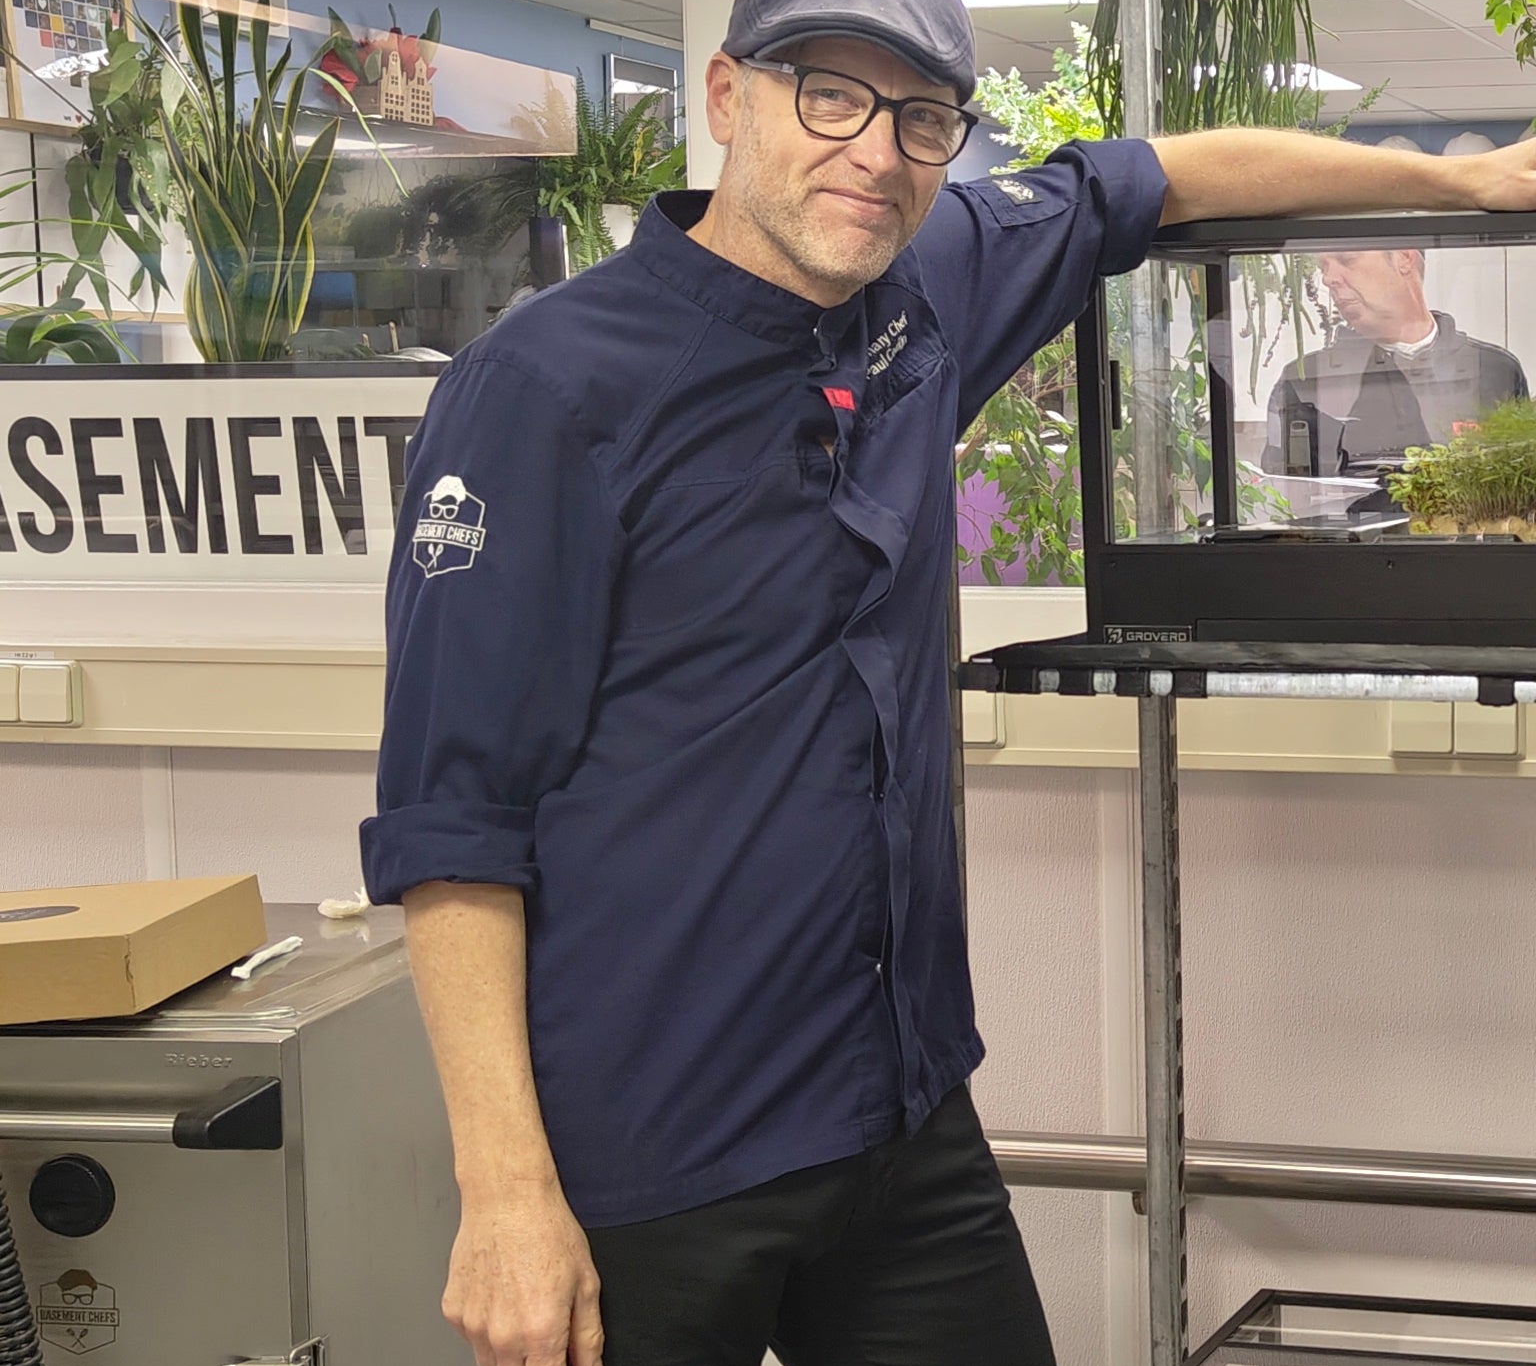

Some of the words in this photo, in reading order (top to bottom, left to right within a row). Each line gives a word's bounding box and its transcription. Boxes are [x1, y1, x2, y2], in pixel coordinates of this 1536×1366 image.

[888, 310, 908, 336] Chef
[0, 416, 423, 556] SEMENT
[446, 526, 479, 545] CHEFS
[164, 1053, 233, 1068] Rieber
[40, 1309, 86, 1322] BASEMENT
[88, 1311, 116, 1323] CHEFS
